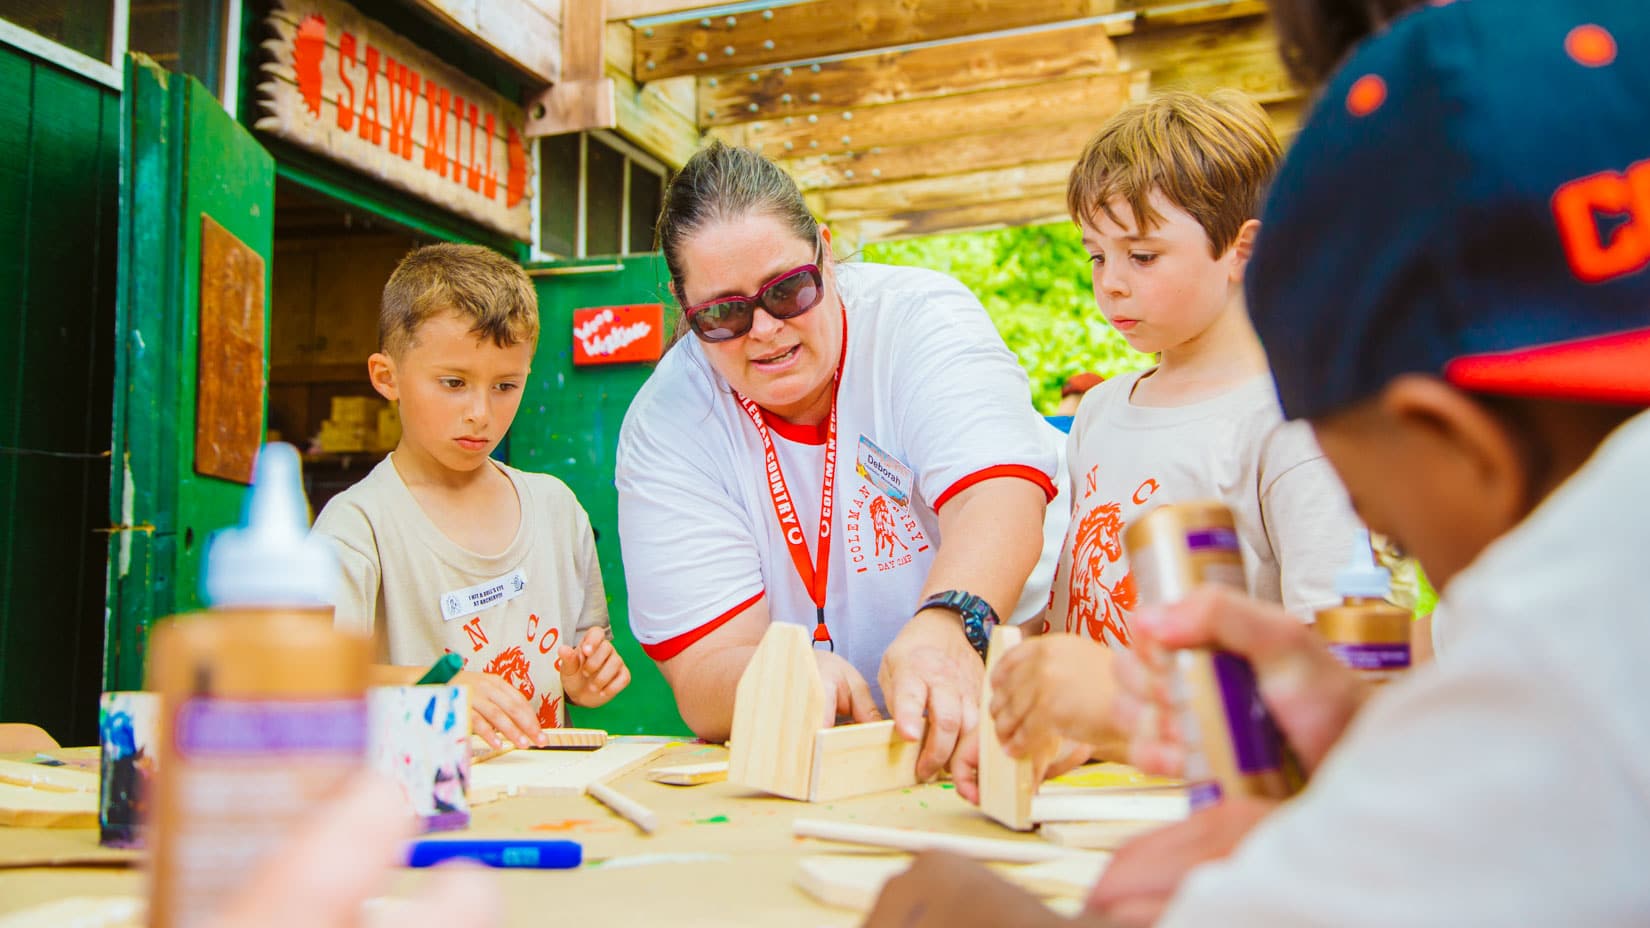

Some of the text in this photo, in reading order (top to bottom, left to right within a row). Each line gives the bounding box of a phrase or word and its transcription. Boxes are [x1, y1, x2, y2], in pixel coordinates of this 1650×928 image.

[738, 393, 797, 525] OLEMAN COUNTRY
[823, 438, 837, 518] COLEMAN
[867, 454, 902, 486] Deborah
[847, 484, 871, 563] COLEMAN
[877, 561, 895, 572] DAY
